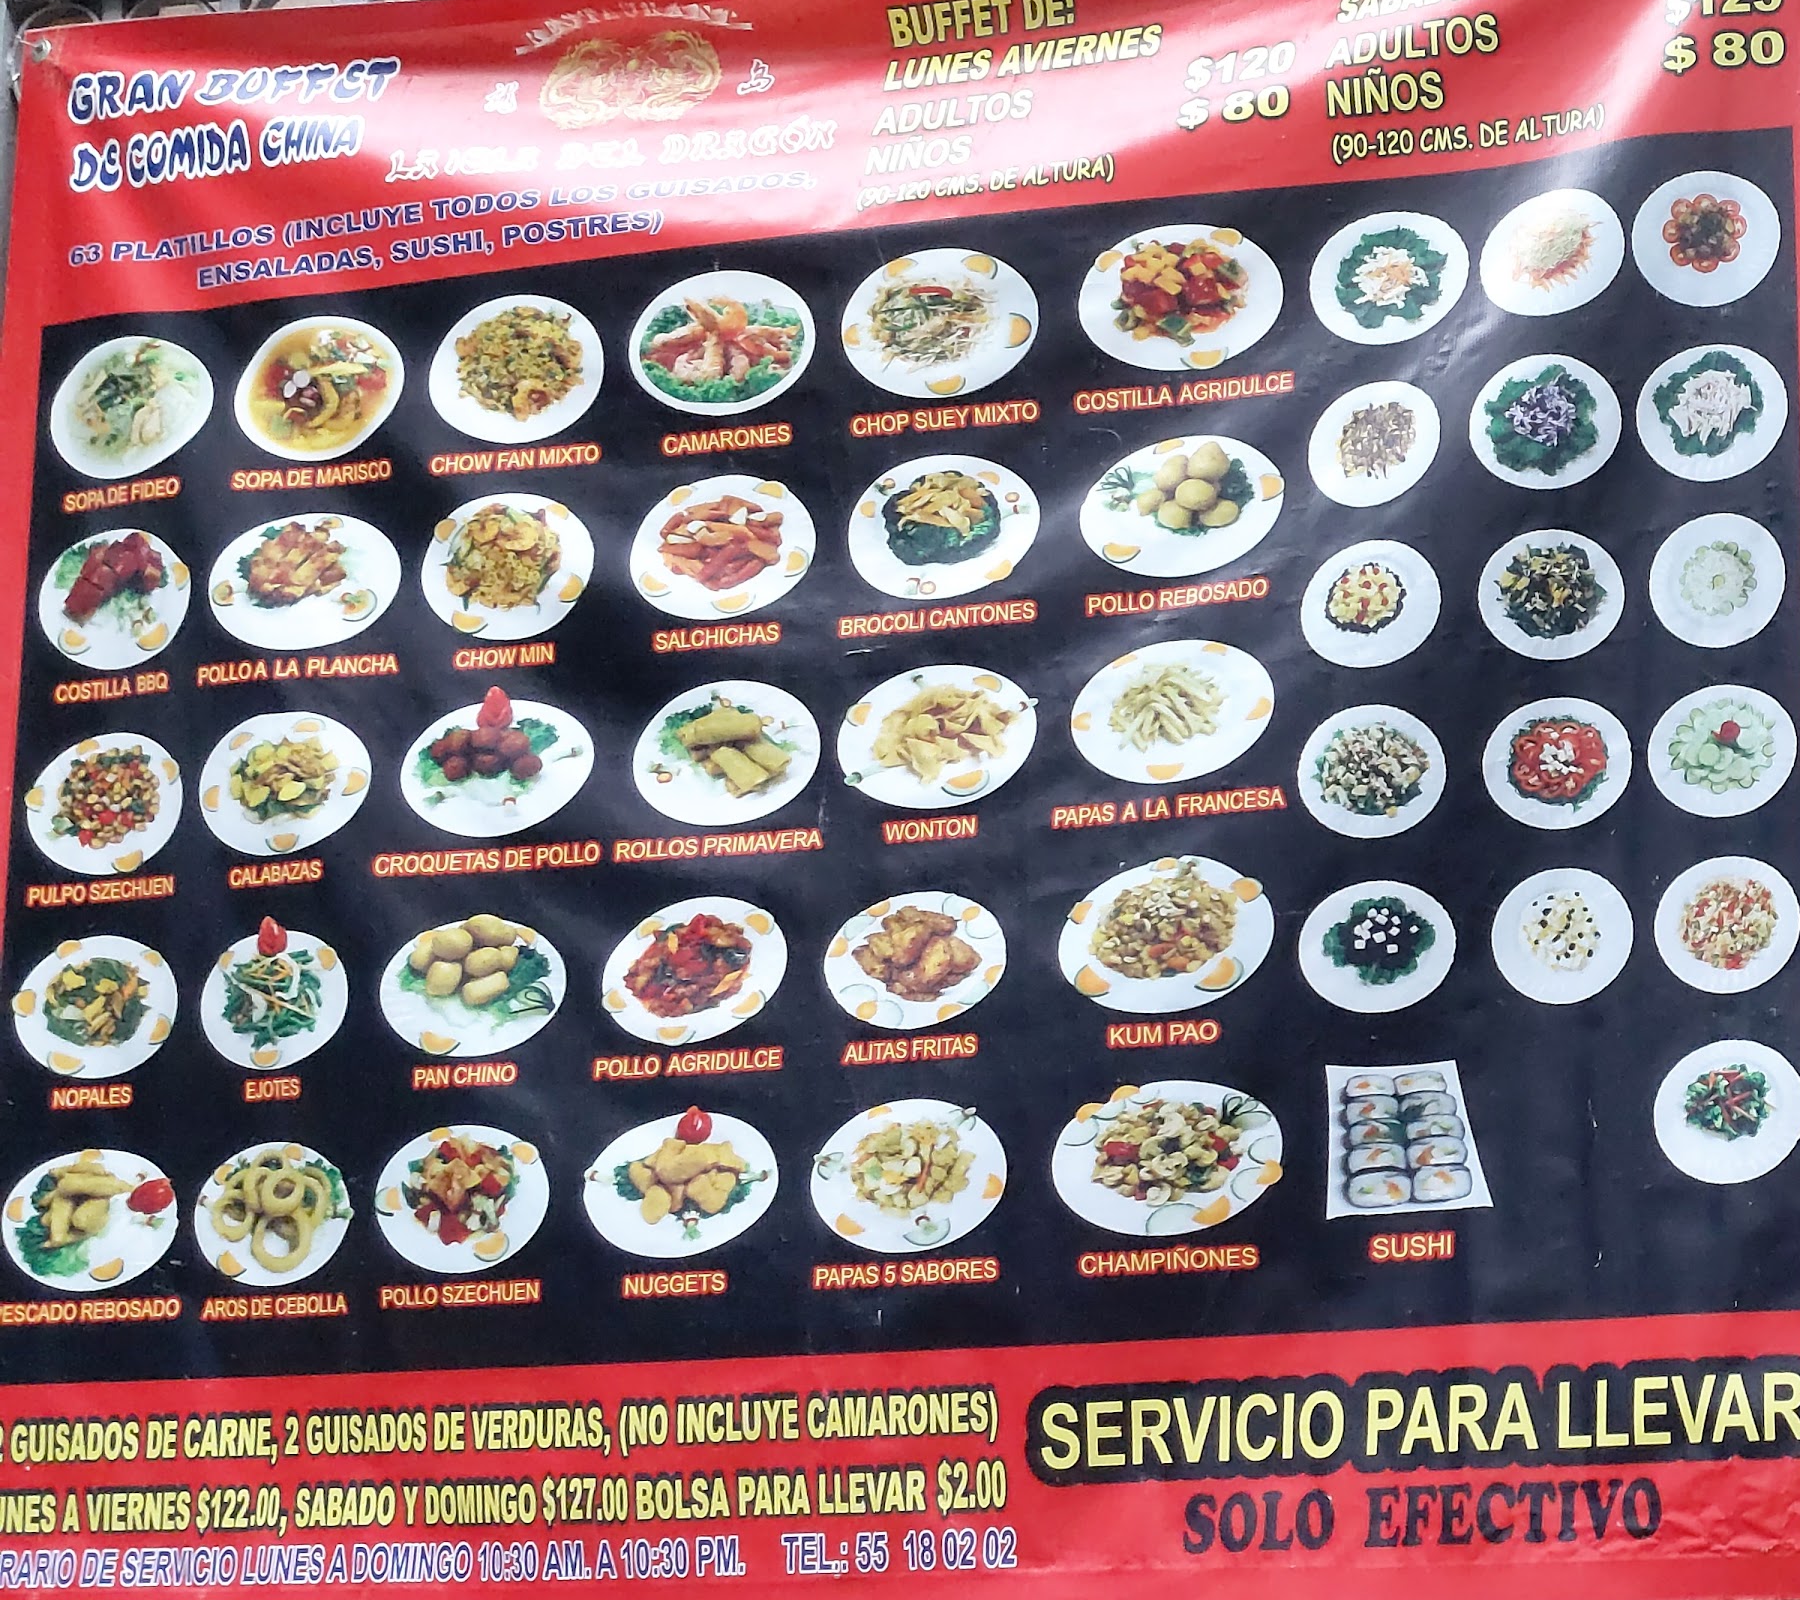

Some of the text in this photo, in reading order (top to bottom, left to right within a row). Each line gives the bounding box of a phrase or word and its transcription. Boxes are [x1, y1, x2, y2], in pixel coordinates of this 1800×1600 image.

[1325, 13, 1500, 69] ADULTOS
[883, 48, 992, 92] LUNES
[68, 70, 196, 124] GRAN
[871, 41, 1297, 137] ADULTOS $120
[1326, 66, 1445, 118] NIÑOS
[1331, 104, 1605, 166] (90-120 CMS. DE ALTURA)
[69, 114, 364, 192] DE COMIDA CHINA
[863, 135, 973, 176] NIÑOS
[989, 153, 1116, 191] DE ALTURA)
[69, 170, 816, 266] 63 PLATILLOS (INCLUYE TODOS LOS GUISADOS,
[196, 210, 664, 290] ENSALADAS, SUSHI, POSTRES)
[1075, 371, 1294, 415] COSTILLA AGRIDULCE
[850, 400, 1039, 438] CHOP SUEY MIXTO
[661, 423, 793, 457] CAMARONES
[231, 459, 392, 491] SOPA DE MARISCO
[430, 443, 600, 475] CHOW FAN MIXTO
[130, 476, 180, 504] FIDEO
[1086, 577, 1269, 616] POLLO REBOSADO
[653, 622, 781, 652] SALCHICHAS
[838, 601, 1038, 640] BROCOLI CANTONES
[306, 653, 398, 678] PLANCHA
[454, 643, 555, 672] CHOW MIN
[54, 676, 132, 705] COSTILLA
[1053, 787, 1286, 828] PAPAS FRANCESA
[613, 829, 822, 862] ROLLOS PRIMAVERA
[884, 816, 978, 843] WONTON
[229, 860, 323, 889] CALABAZAS
[372, 842, 600, 877] CROQUETAS DE POLLO
[27, 875, 175, 907] PULPO SZECHUEN
[843, 1033, 979, 1065] ALITAS FRITAS
[1107, 1020, 1219, 1049] KUM PAO
[413, 1061, 517, 1087] PAN CHINO
[594, 1047, 783, 1079] POLLO AGRIDULCE
[52, 1085, 133, 1110] NOPALES
[244, 1078, 301, 1101] EJOTES
[1078, 1244, 1259, 1278] CHAMPIÑONES
[1371, 1232, 1456, 1263] SUSHI
[622, 1272, 727, 1297] NUGGETS
[813, 1257, 1001, 1289] PAPAS SABORES
[80, 1298, 181, 1320] REBOSADO
[202, 1293, 348, 1318] AROS CEBOLLA
[380, 1280, 540, 1309] POLLO SZECHUEN
[11, 1417, 140, 1465] GUISADOS
[146, 1415, 179, 1460] DE
[184, 1412, 279, 1466] CARNE,
[305, 1407, 427, 1455] GUISADOS
[433, 1404, 466, 1452] DE
[471, 1403, 612, 1455] VERDURAS,
[619, 1398, 670, 1457] (NO
[676, 1395, 799, 1444] INCLUYE
[807, 1386, 1000, 1443] CAMARONES)
[1039, 1387, 1345, 1471] SERVICIO
[1364, 1380, 1538, 1457] PARA
[86, 1458, 1007, 1538] VIERNES $122.00, SABADO DOMINGO $127.00 BOLSA PARA LLEVAR $2.00
[1183, 1476, 1664, 1555] SOLO EFECTIVO
[80, 1547, 117, 1588] DE
[121, 1543, 236, 1587] SERVICIO
[241, 1542, 325, 1586] LUNES
[351, 1540, 471, 1585] DOMINGO
[477, 1539, 540, 1583] 10:30
[542, 1539, 591, 1581] AM.
[621, 1537, 688, 1579] 10:30
[697, 1534, 746, 1577] PM.
[855, 1530, 888, 1573] 55
[903, 1530, 935, 1572] 18
[942, 1527, 975, 1570] 02
[983, 1525, 1017, 1568] 02
